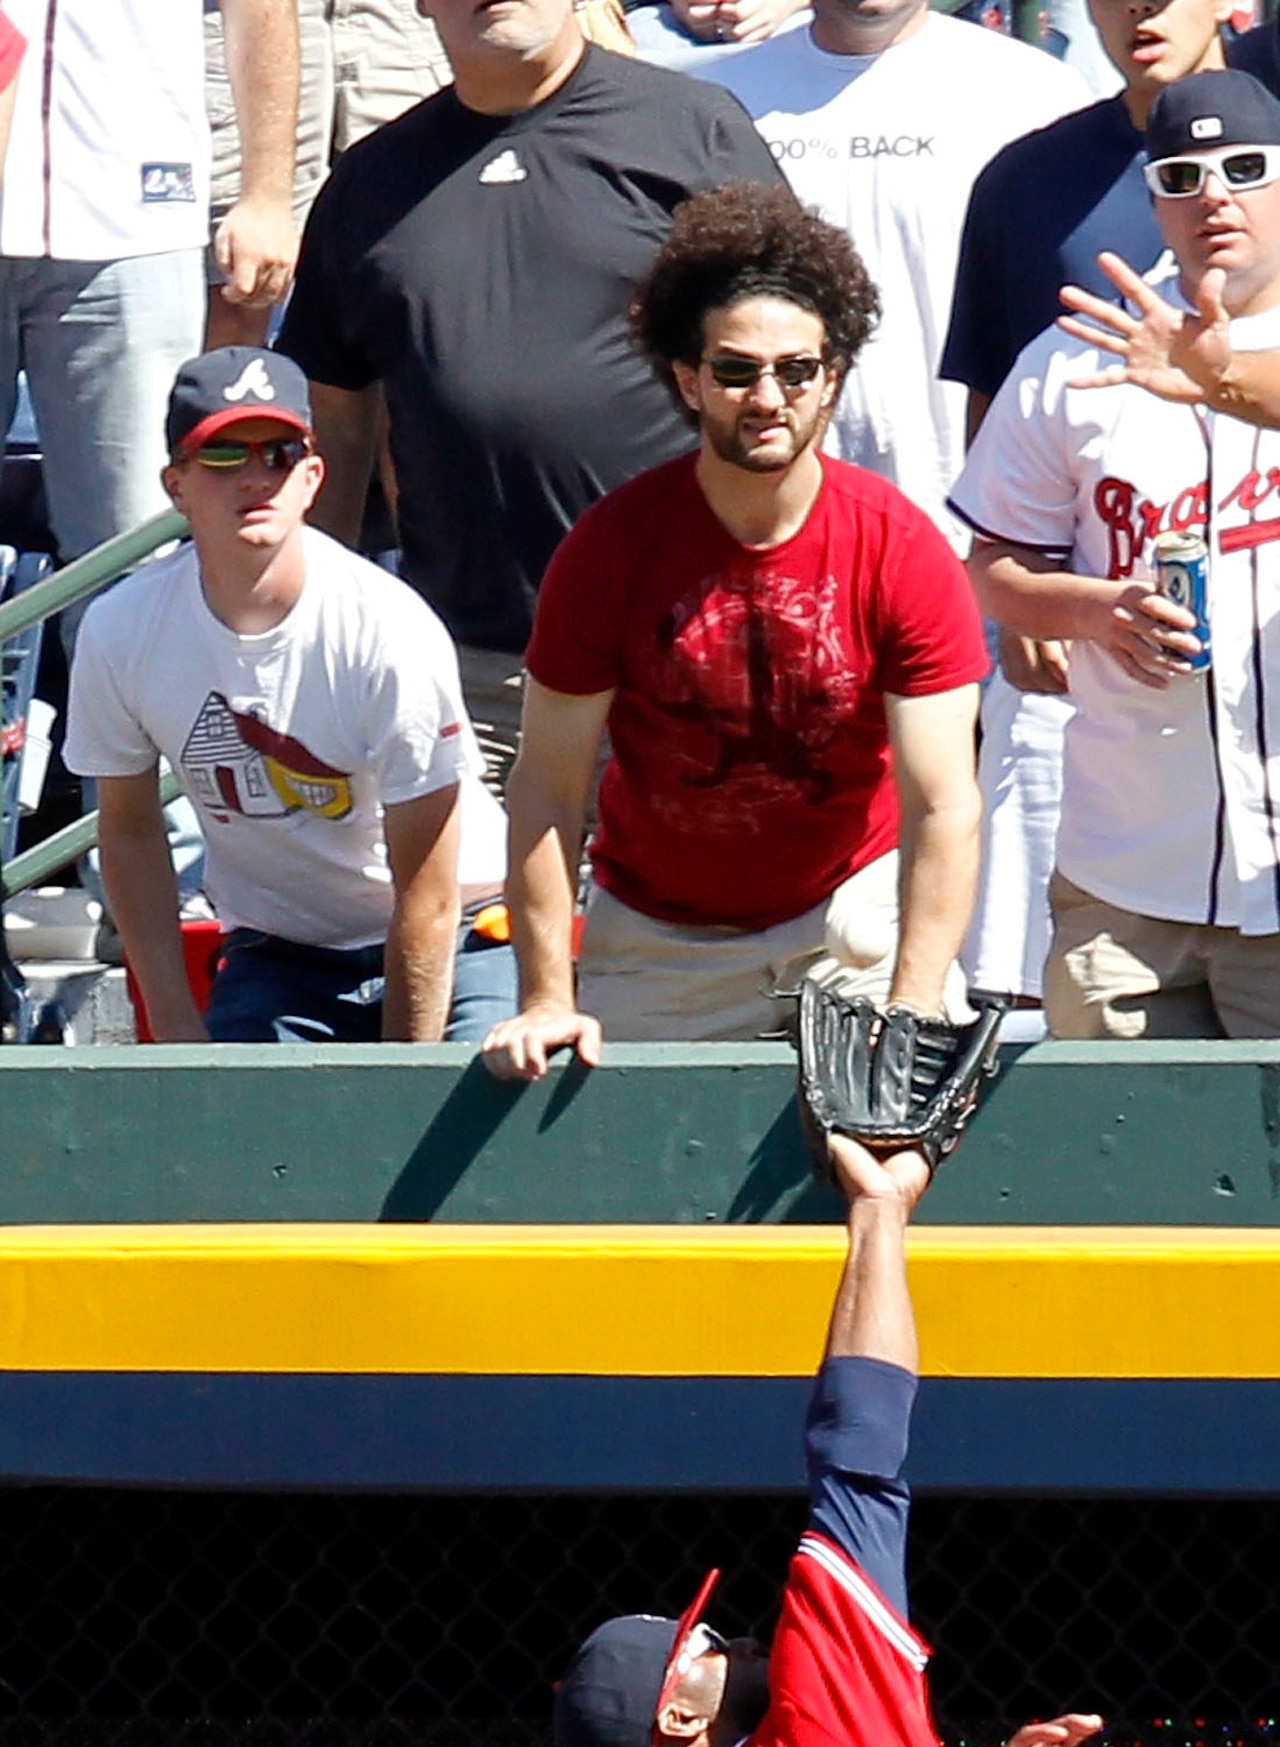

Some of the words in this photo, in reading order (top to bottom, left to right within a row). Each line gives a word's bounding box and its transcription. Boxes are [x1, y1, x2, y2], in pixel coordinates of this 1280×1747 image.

[767, 136, 838, 160] 00%
[849, 134, 935, 159] BACK
[223, 356, 276, 402] A
